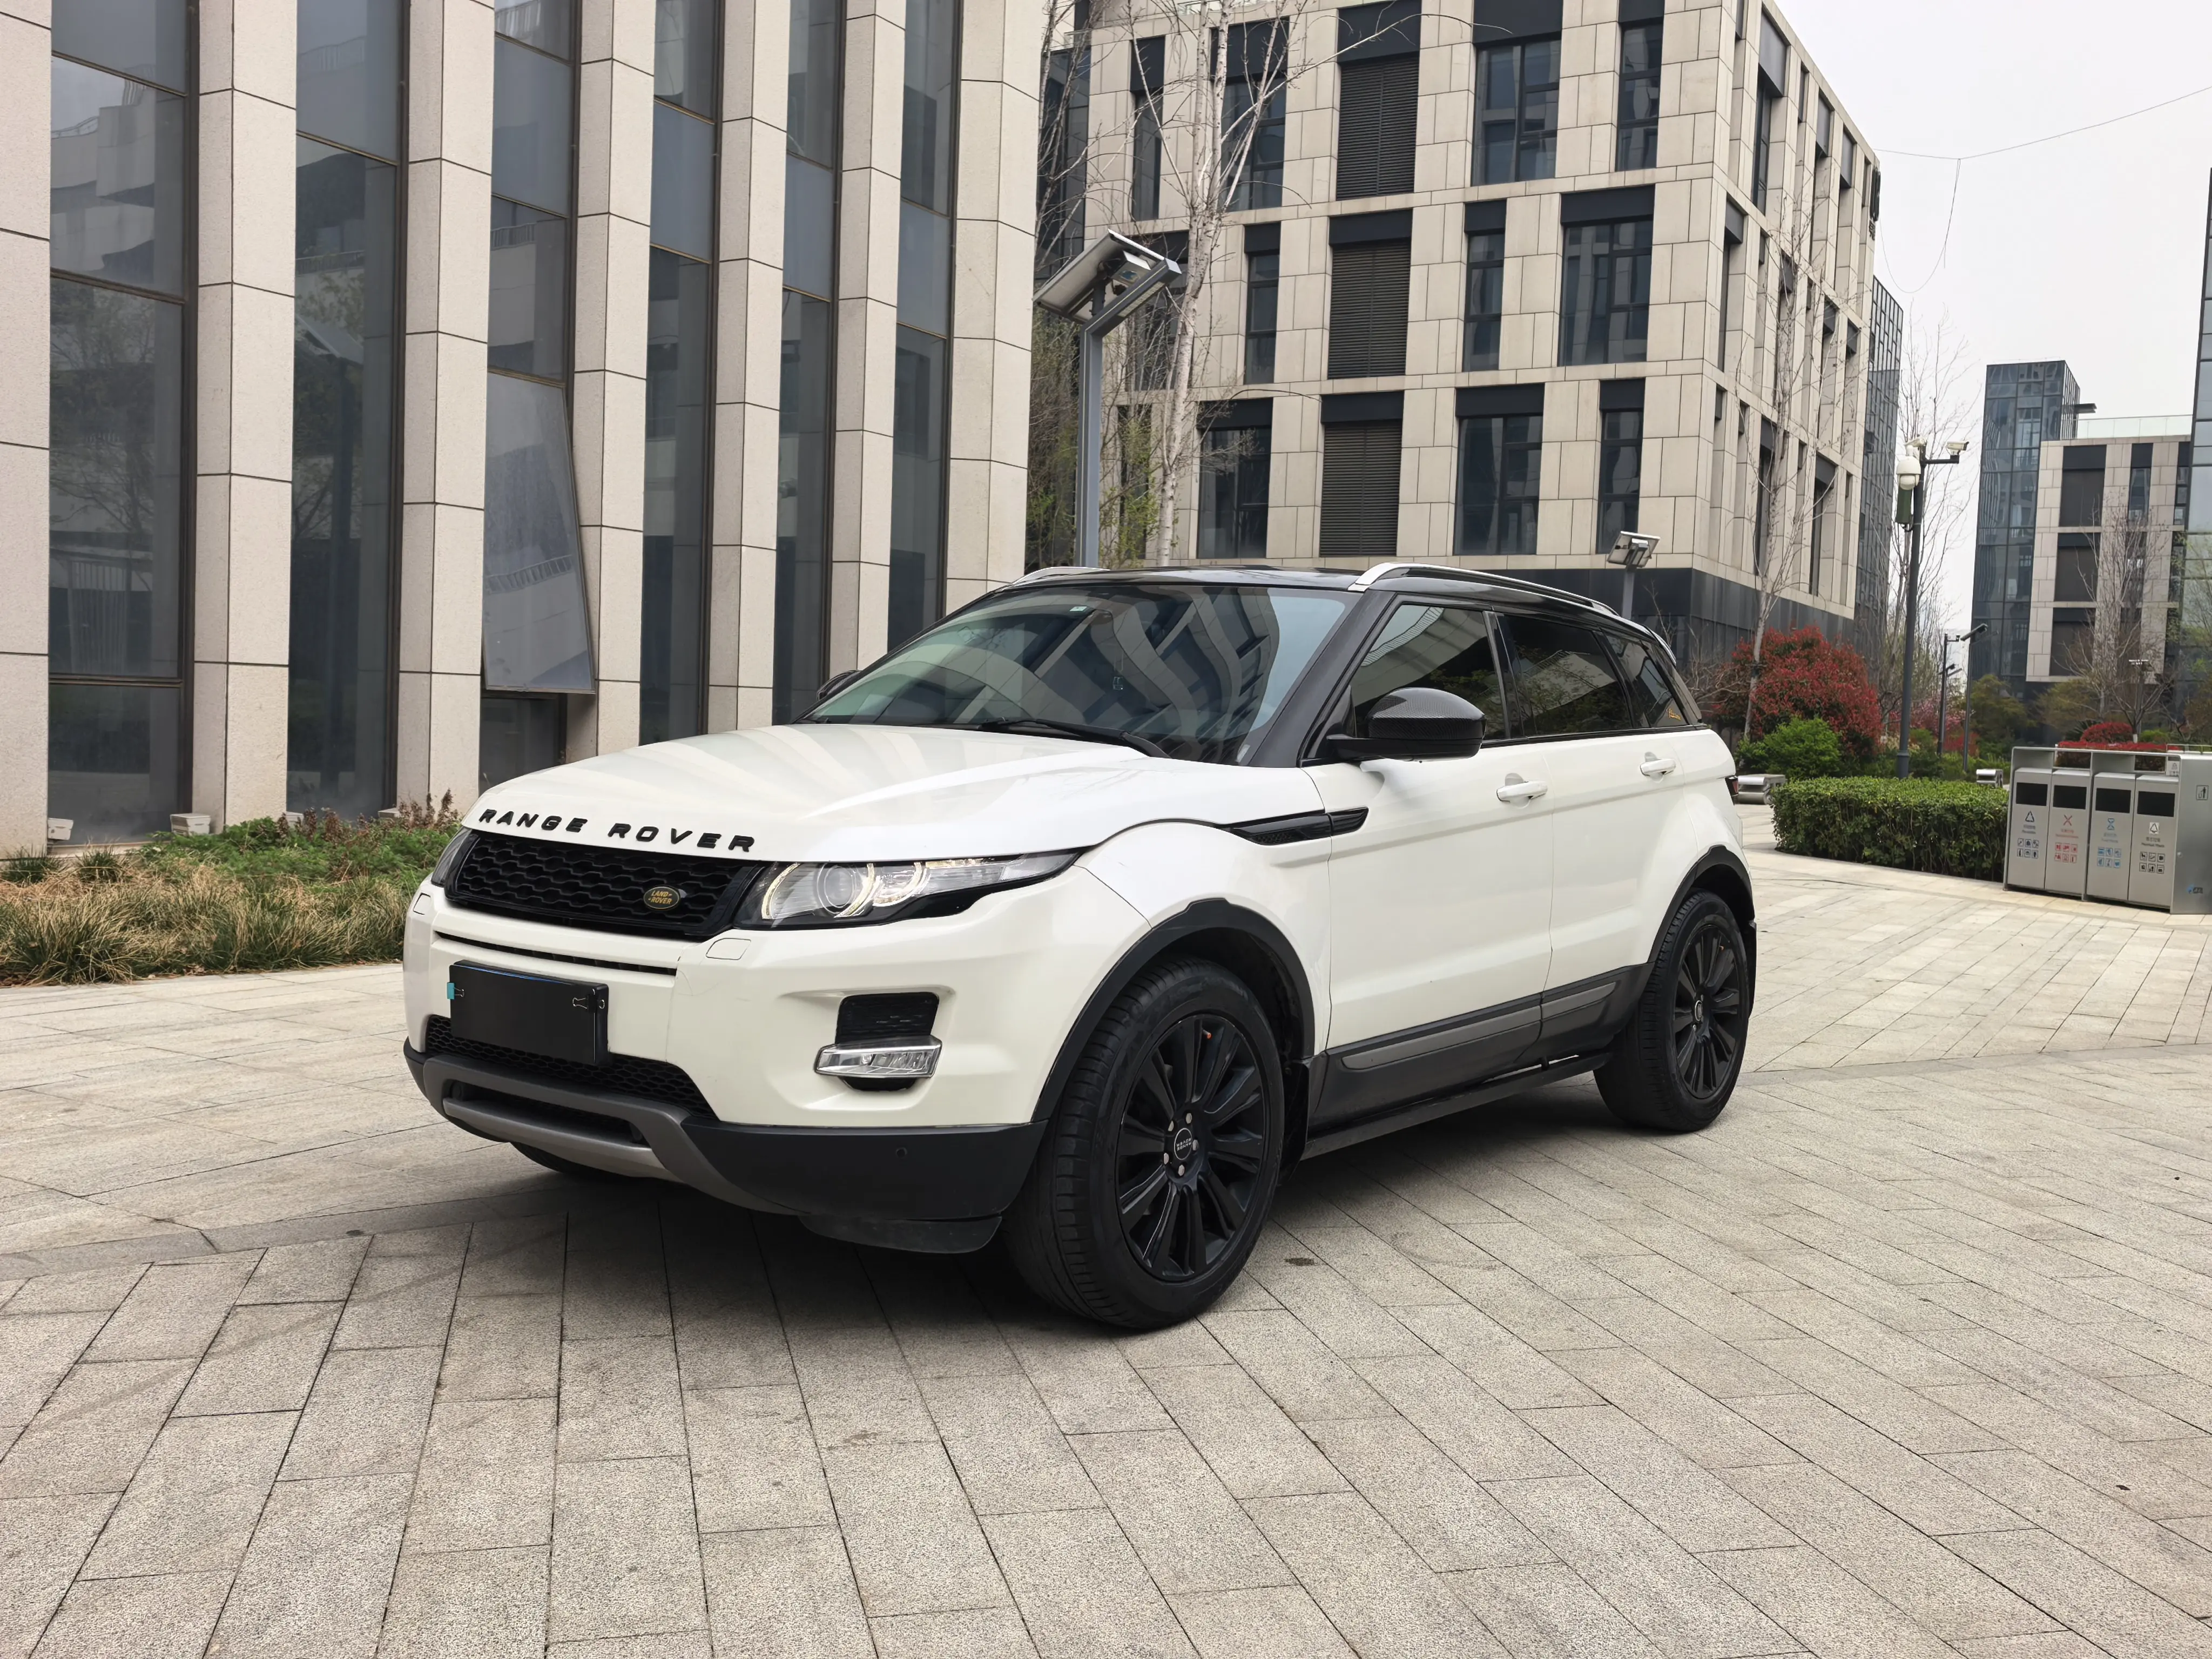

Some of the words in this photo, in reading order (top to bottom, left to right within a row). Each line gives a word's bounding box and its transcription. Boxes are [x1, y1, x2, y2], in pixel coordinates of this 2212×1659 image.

[478, 808, 588, 833] RANGE
[608, 822, 755, 853] ROVER
[651, 896, 672, 905] ROVER
